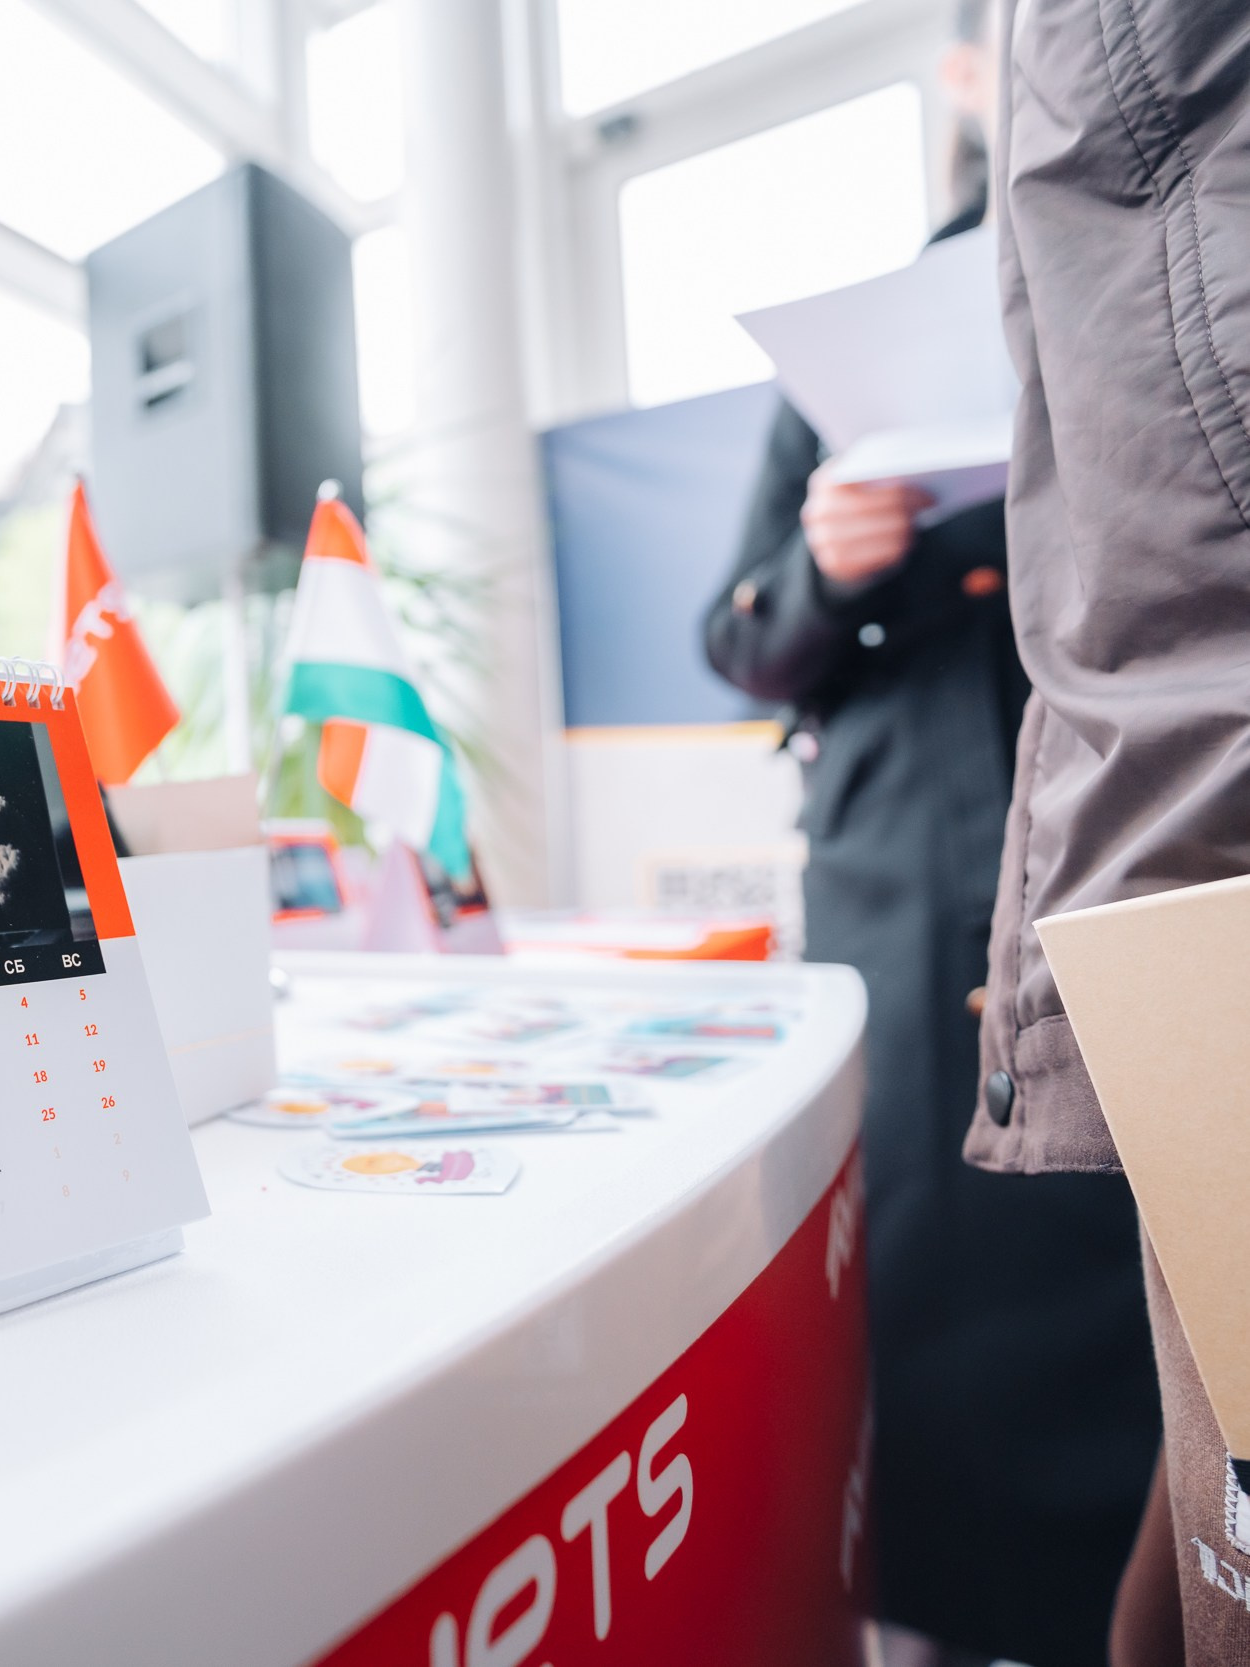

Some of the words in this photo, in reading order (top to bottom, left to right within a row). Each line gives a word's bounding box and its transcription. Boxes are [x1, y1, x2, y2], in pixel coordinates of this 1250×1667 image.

[3, 958, 26, 975] СБ
[61, 952, 82, 968] ВС
[20, 996, 29, 1009] 4
[79, 988, 87, 1001] 5
[25, 1032, 40, 1046] 11
[84, 1023, 99, 1037] 12
[33, 1070, 48, 1084] 18
[92, 1059, 106, 1073] 19
[41, 1107, 56, 1122] 25
[101, 1095, 116, 1109] 26
[429, 1392, 694, 1667] eTS
